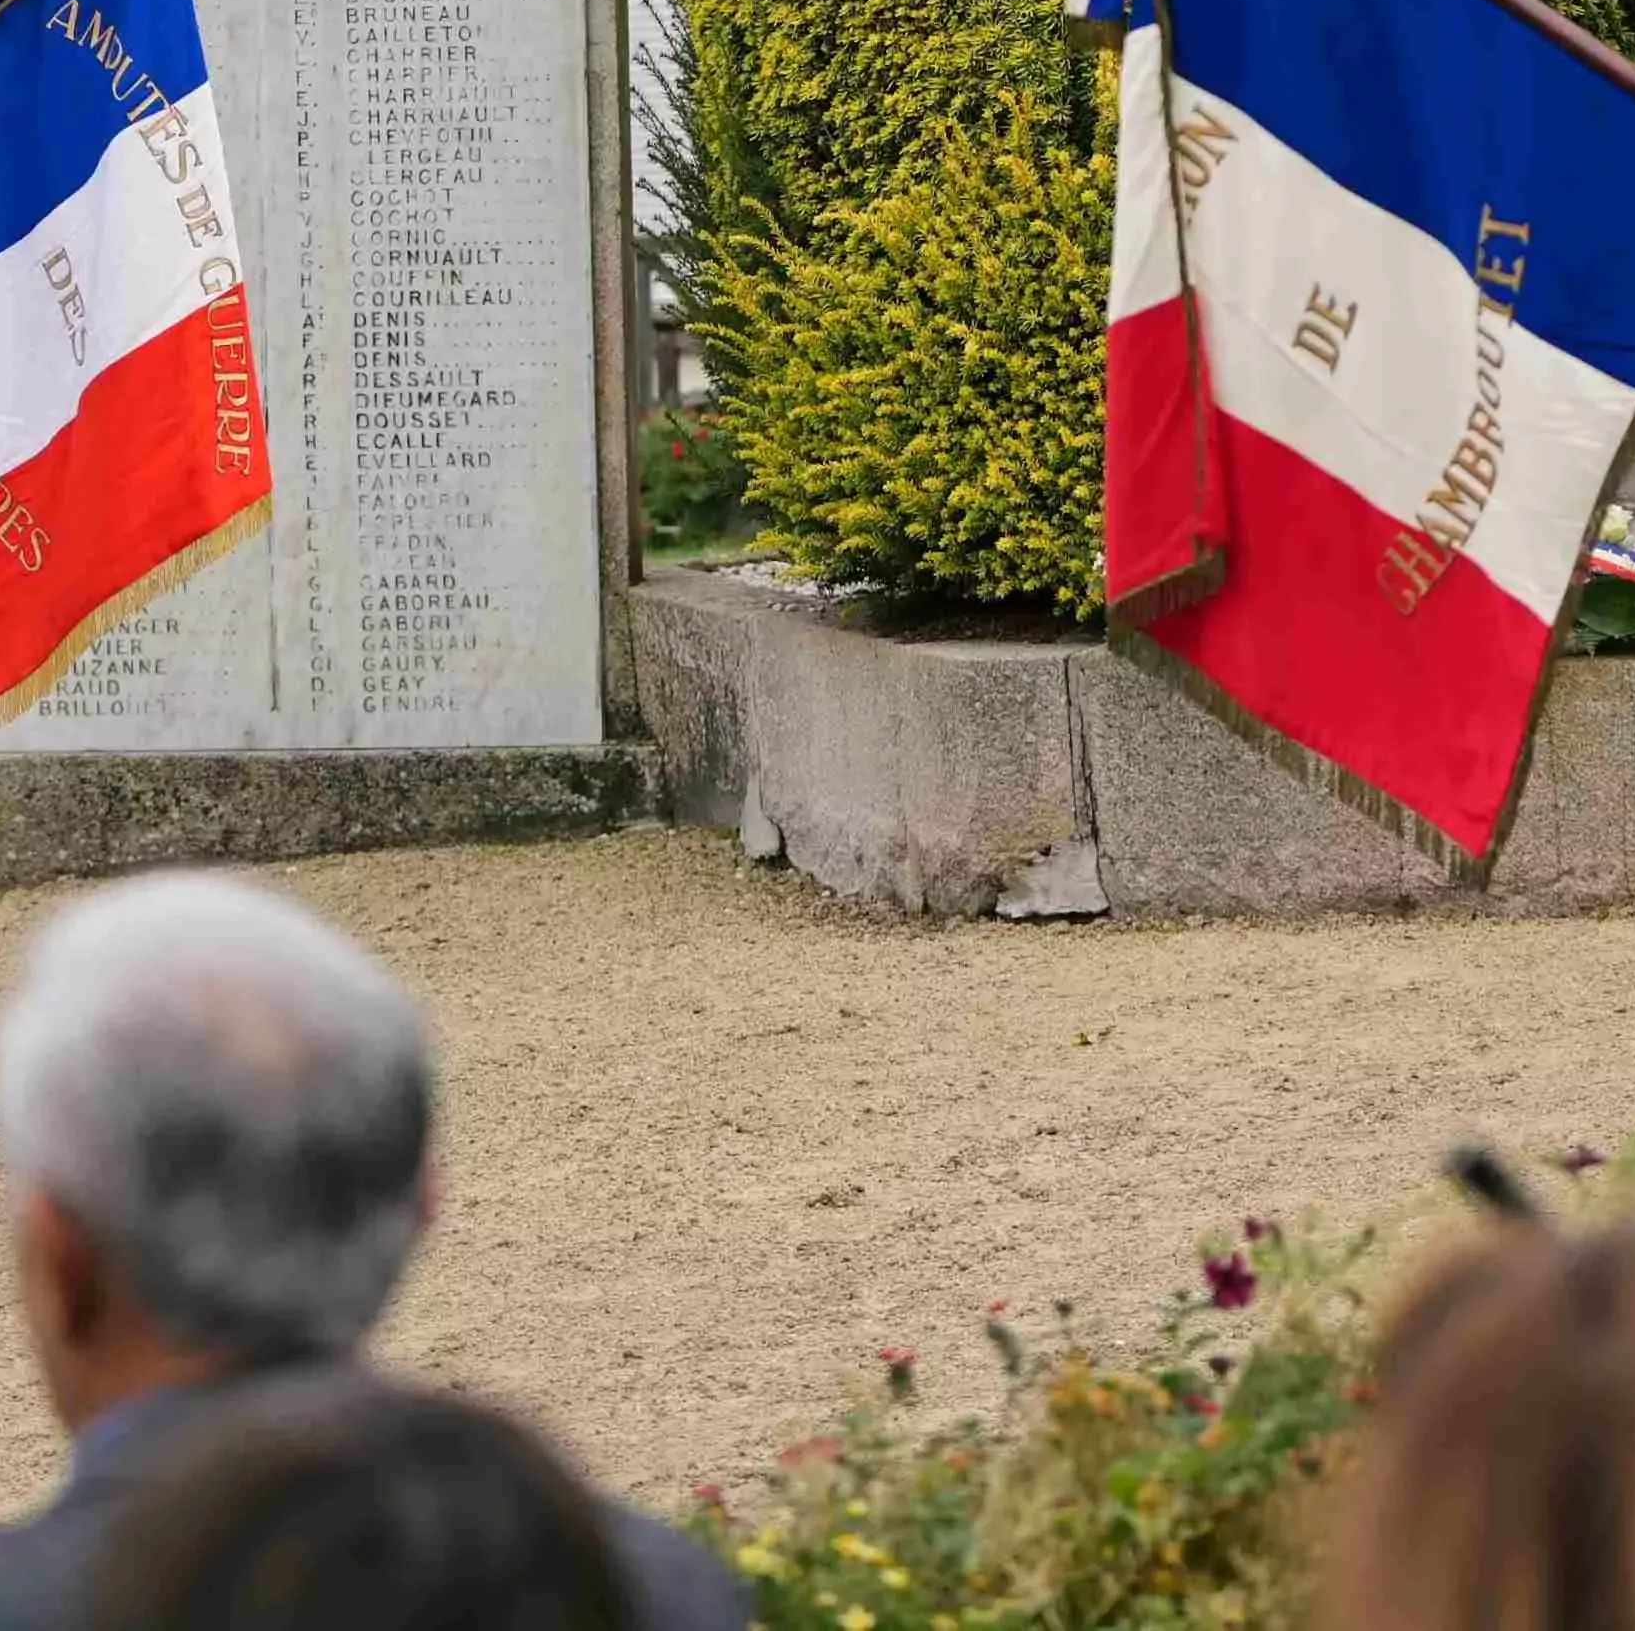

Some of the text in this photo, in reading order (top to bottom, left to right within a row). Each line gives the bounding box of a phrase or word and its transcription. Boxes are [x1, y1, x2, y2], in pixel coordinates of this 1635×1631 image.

[346, 6, 470, 23] BRUNEAU
[347, 26, 482, 45] CAILLETO
[176, 183, 224, 249] DE
[351, 208, 454, 226] COCHOT
[352, 248, 503, 267] CORNUAULT
[353, 289, 513, 308] COURILLEAU
[354, 311, 426, 328] DENIS
[1292, 280, 1359, 377] DE
[354, 331, 426, 348] DENIS
[198, 256, 254, 477] GUERRE
[354, 351, 426, 369] DENIS
[355, 370, 484, 389] DESSAULT
[355, 390, 517, 409] DIEUMEGARD
[356, 412, 471, 429] DOUSSET
[357, 452, 492, 469] EVEILLARD
[360, 574, 456, 591] GABARD
[361, 594, 489, 612] GABOREAU
[363, 676, 426, 693] GEAY
